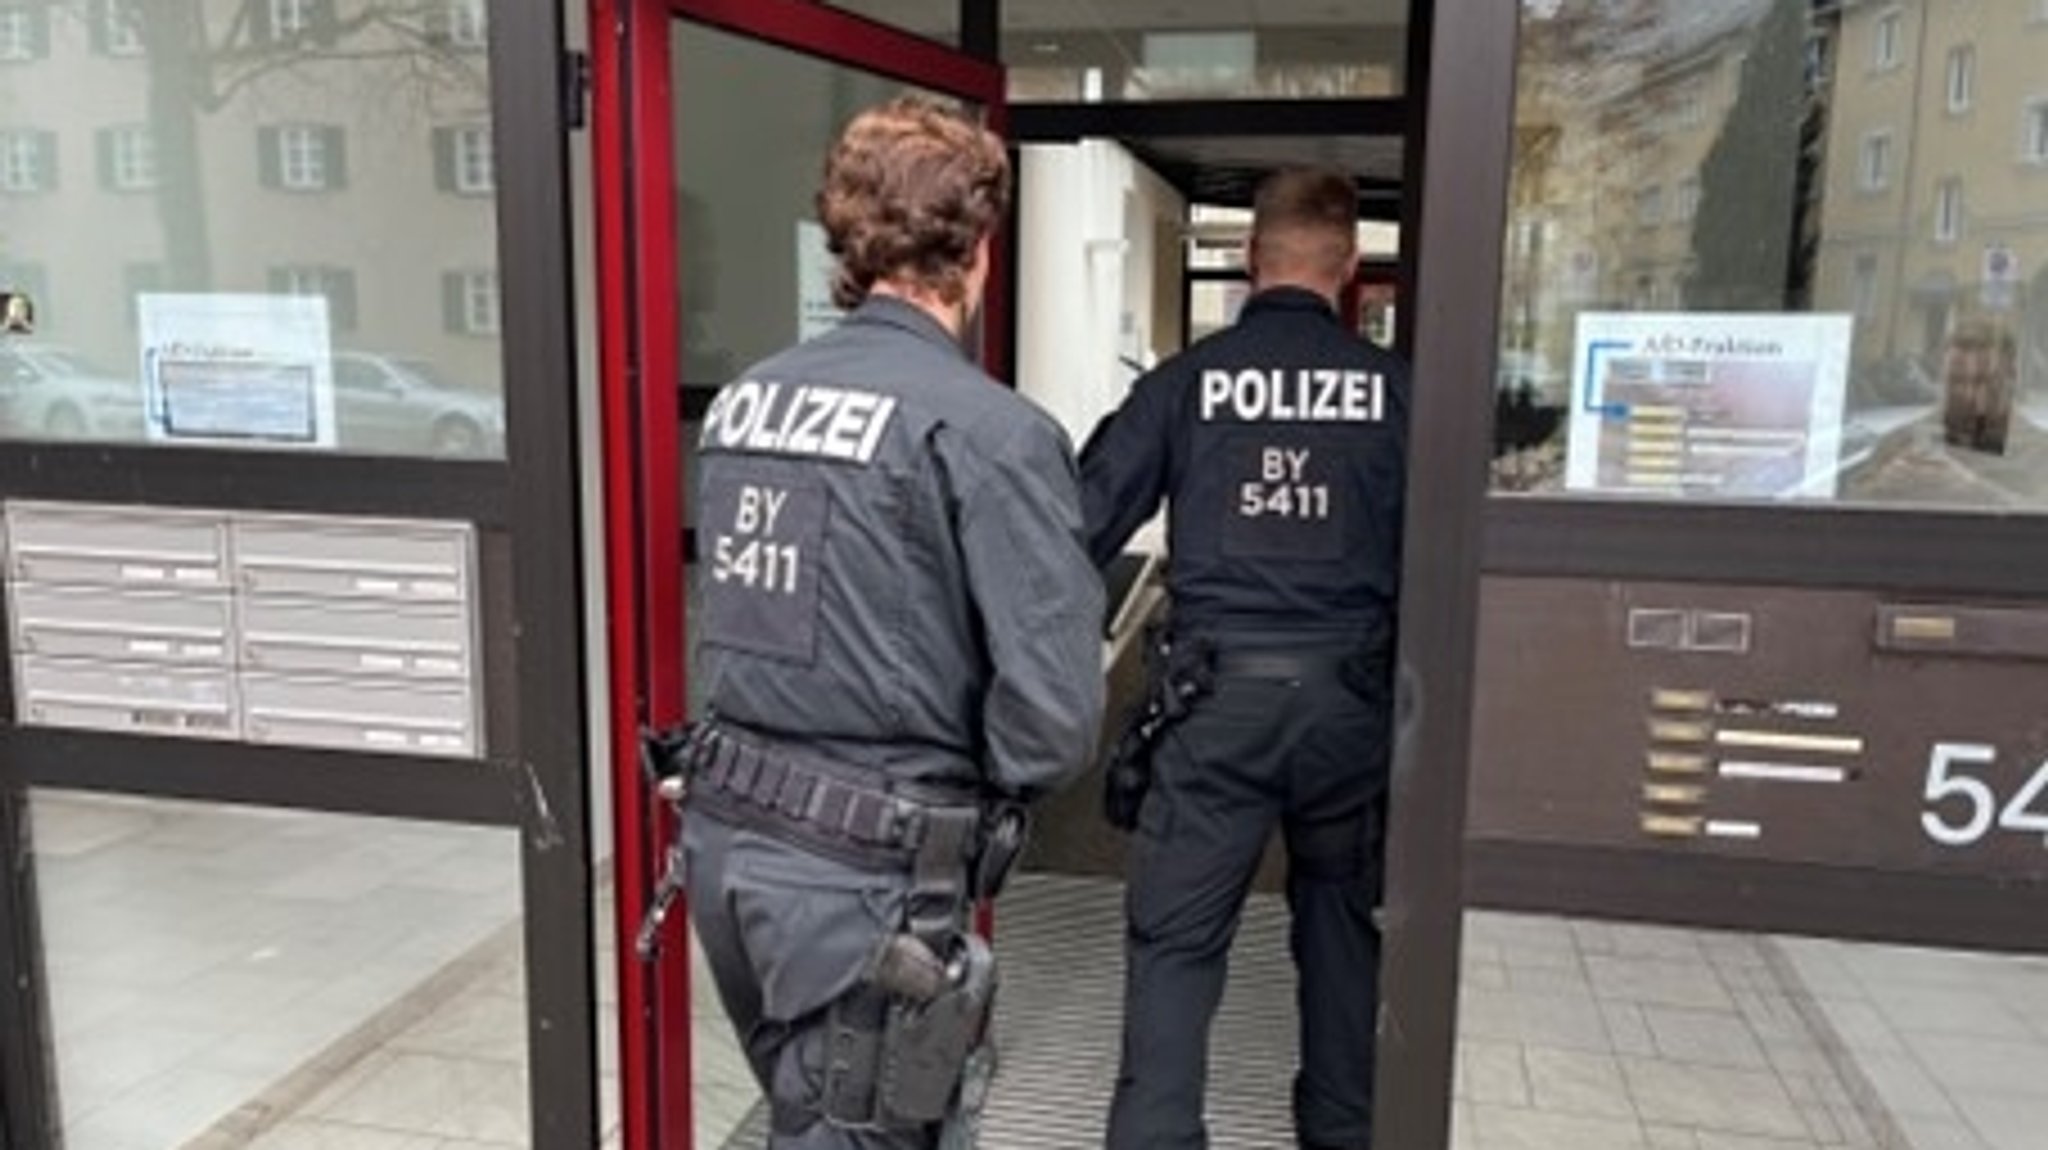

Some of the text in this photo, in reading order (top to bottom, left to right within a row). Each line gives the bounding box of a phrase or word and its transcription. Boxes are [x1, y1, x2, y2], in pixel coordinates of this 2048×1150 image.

[1201, 368, 1385, 421] POLIZEI
[1262, 447, 1310, 481] BY
[735, 486, 787, 536] BY
[1240, 482, 1328, 518] 5411
[712, 535, 798, 594] 5411
